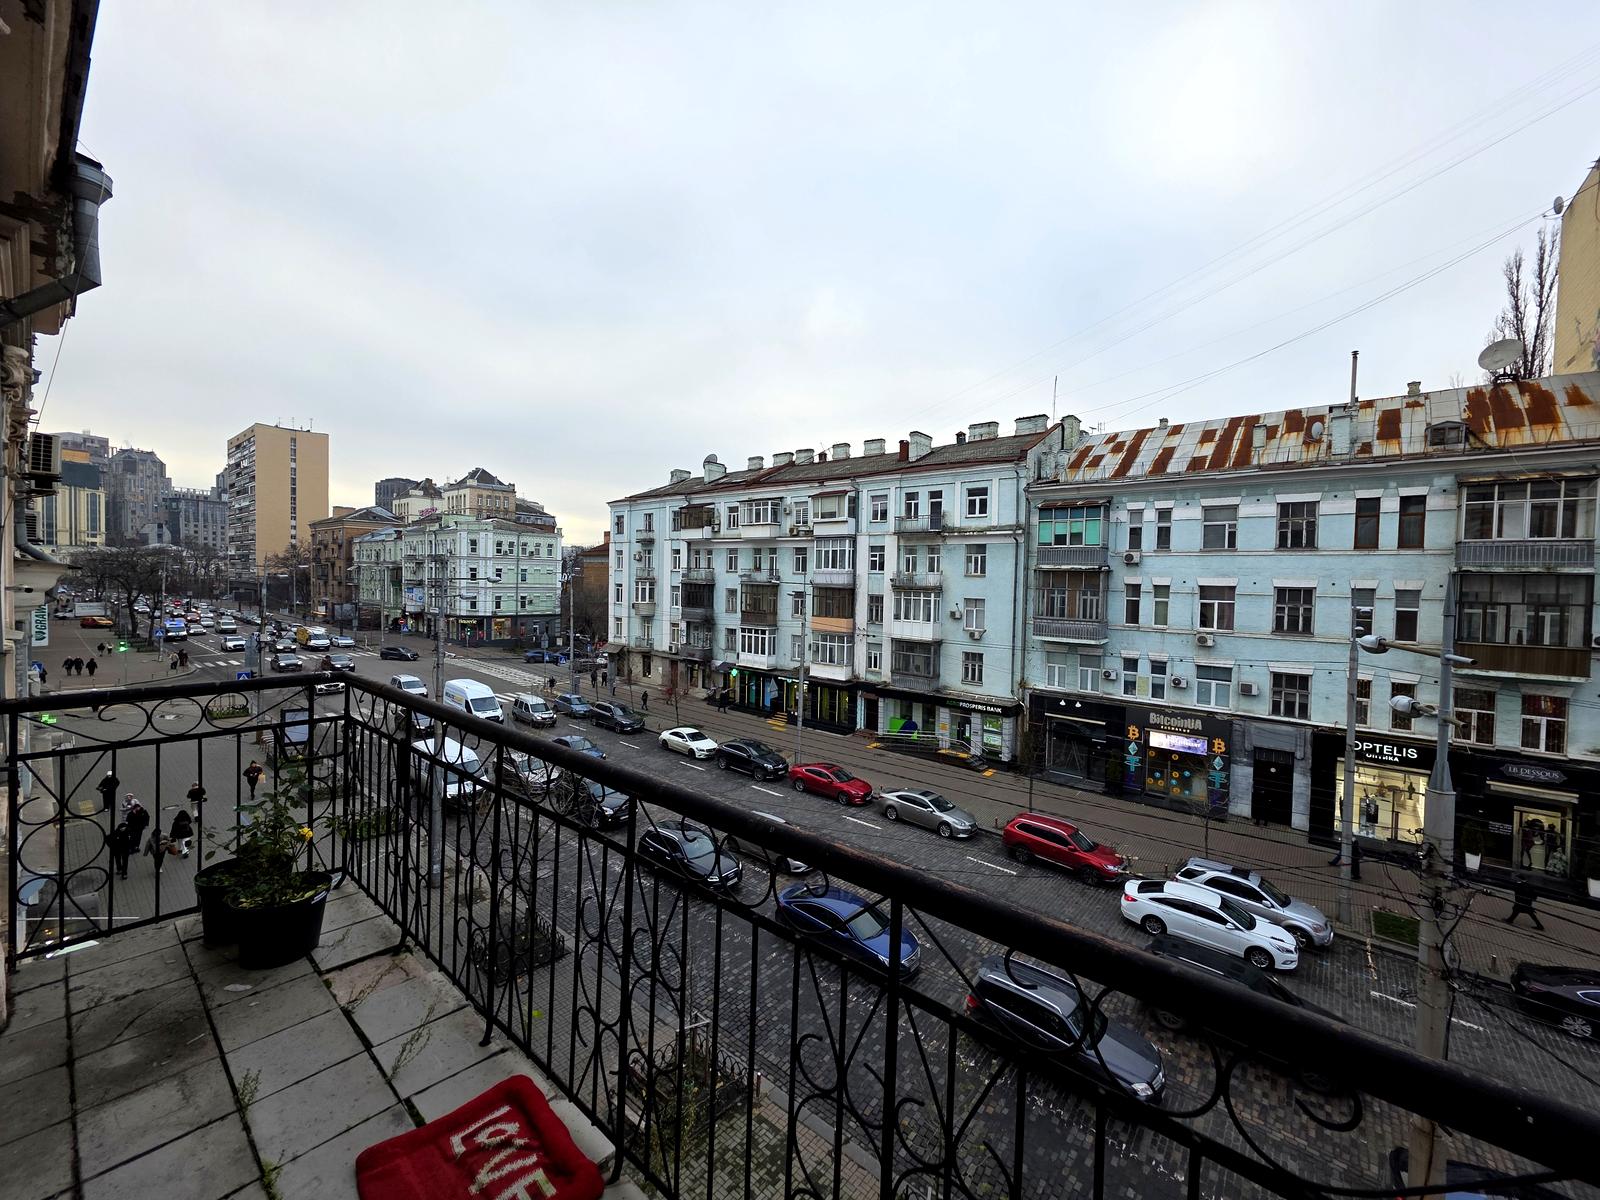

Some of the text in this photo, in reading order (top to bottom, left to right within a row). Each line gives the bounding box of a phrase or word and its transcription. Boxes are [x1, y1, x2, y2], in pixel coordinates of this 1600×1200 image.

[987, 705, 1002, 714] BANK
[1149, 712, 1202, 731] BitcoinUA
[1354, 740, 1418, 759] OPTELIS
[450, 1105, 557, 1200] LOVE
